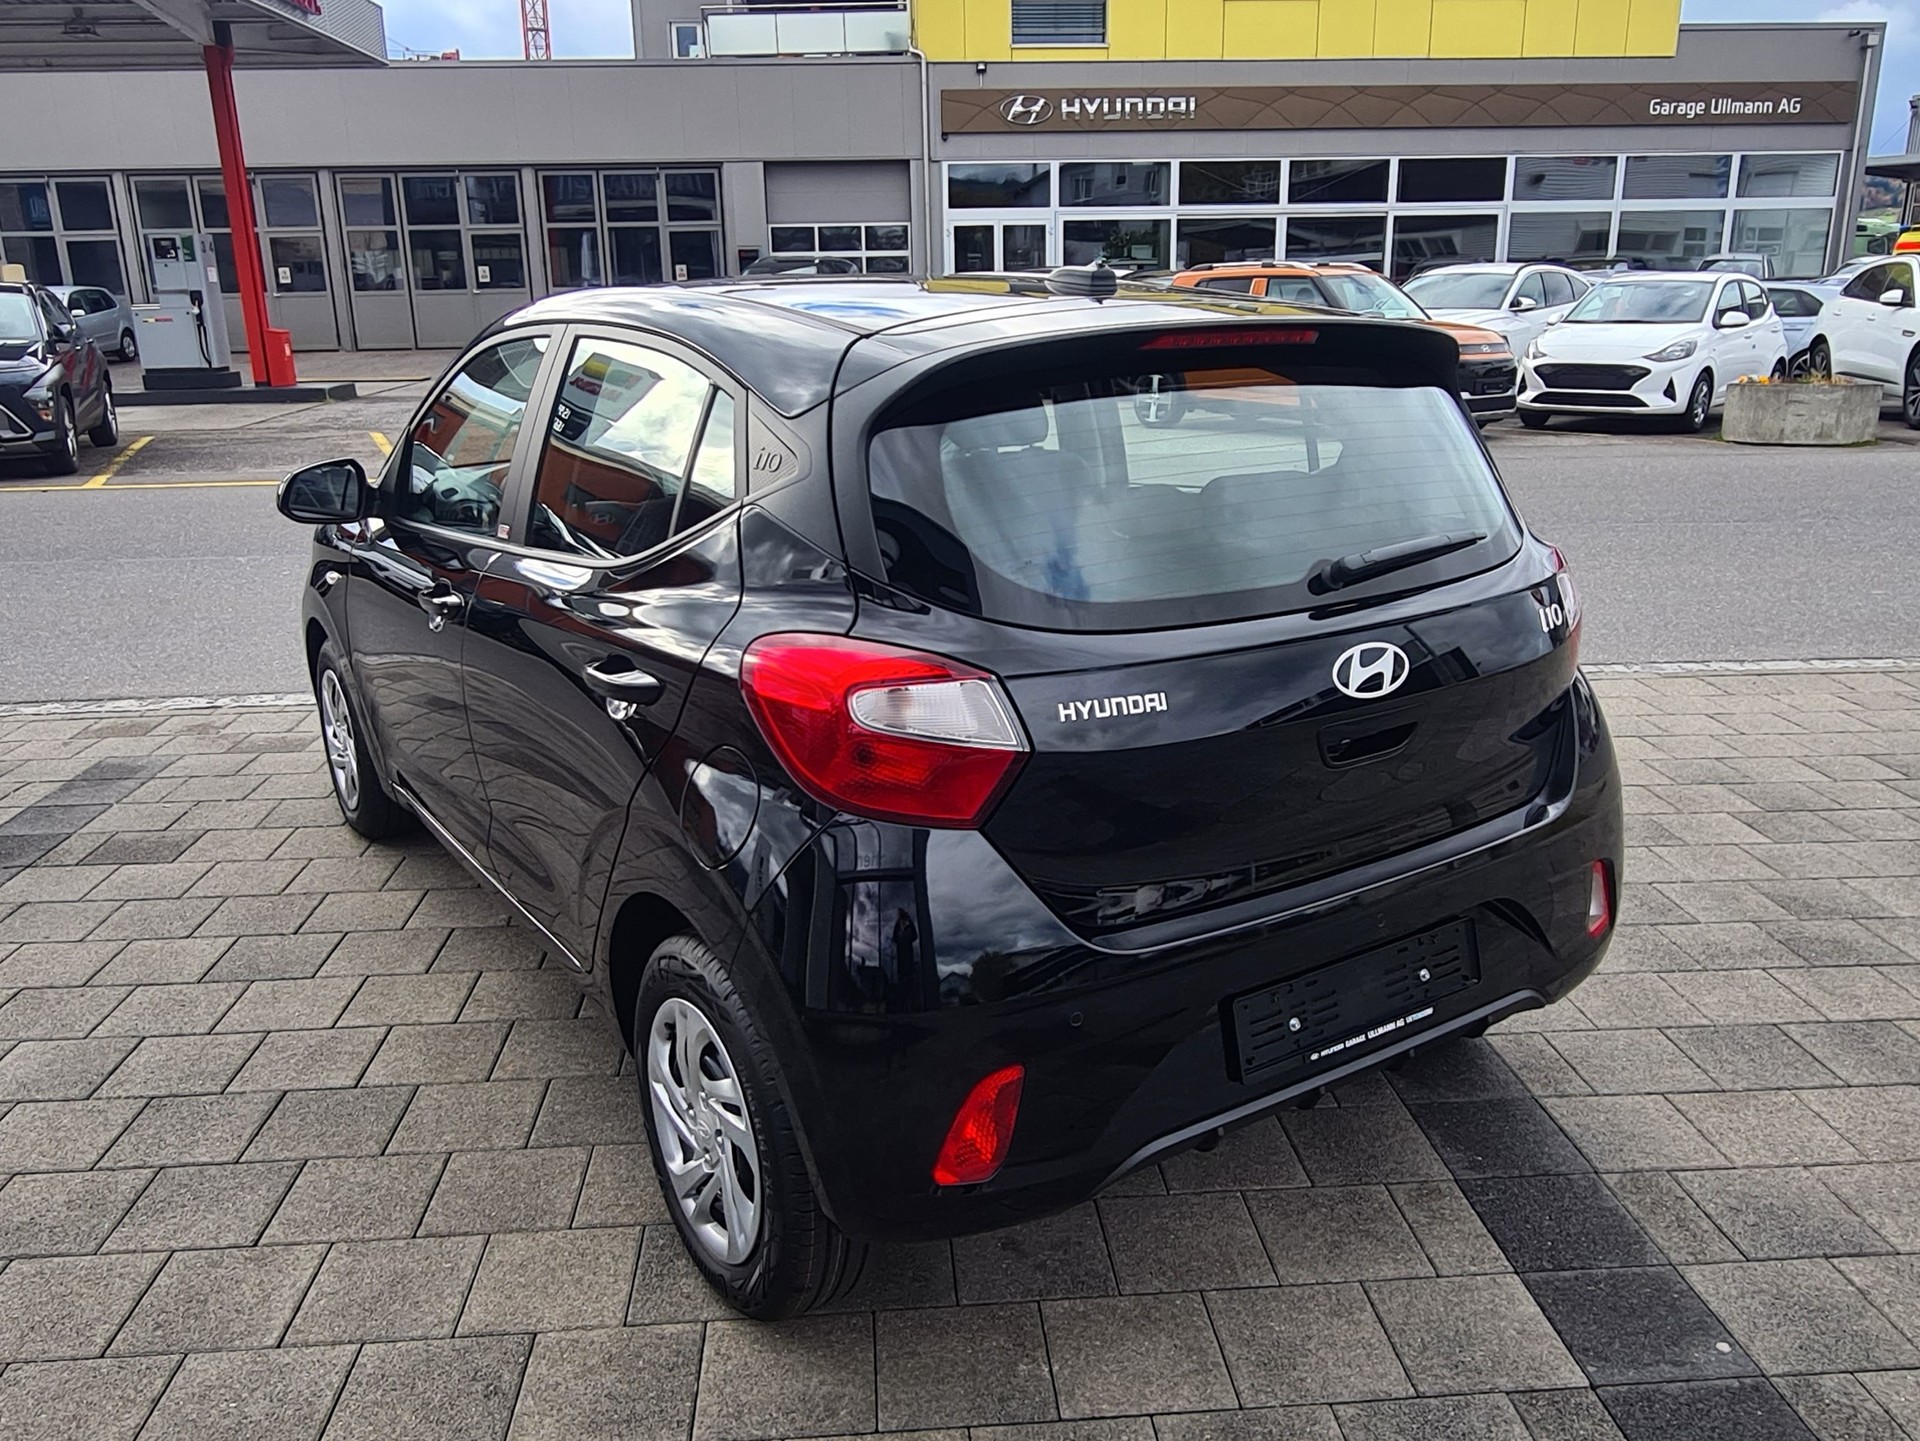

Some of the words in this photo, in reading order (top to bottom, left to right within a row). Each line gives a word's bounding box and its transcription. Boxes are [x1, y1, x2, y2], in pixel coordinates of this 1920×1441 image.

[1060, 96, 1196, 120] HYUNDAI
[1649, 99, 1706, 118] Garage
[1710, 98, 1774, 115] Ullmann
[1777, 97, 1803, 114] AG
[753, 446, 783, 473] i10
[1057, 692, 1169, 723] HYUNDAI
[1396, 1018, 1405, 1027] AG
